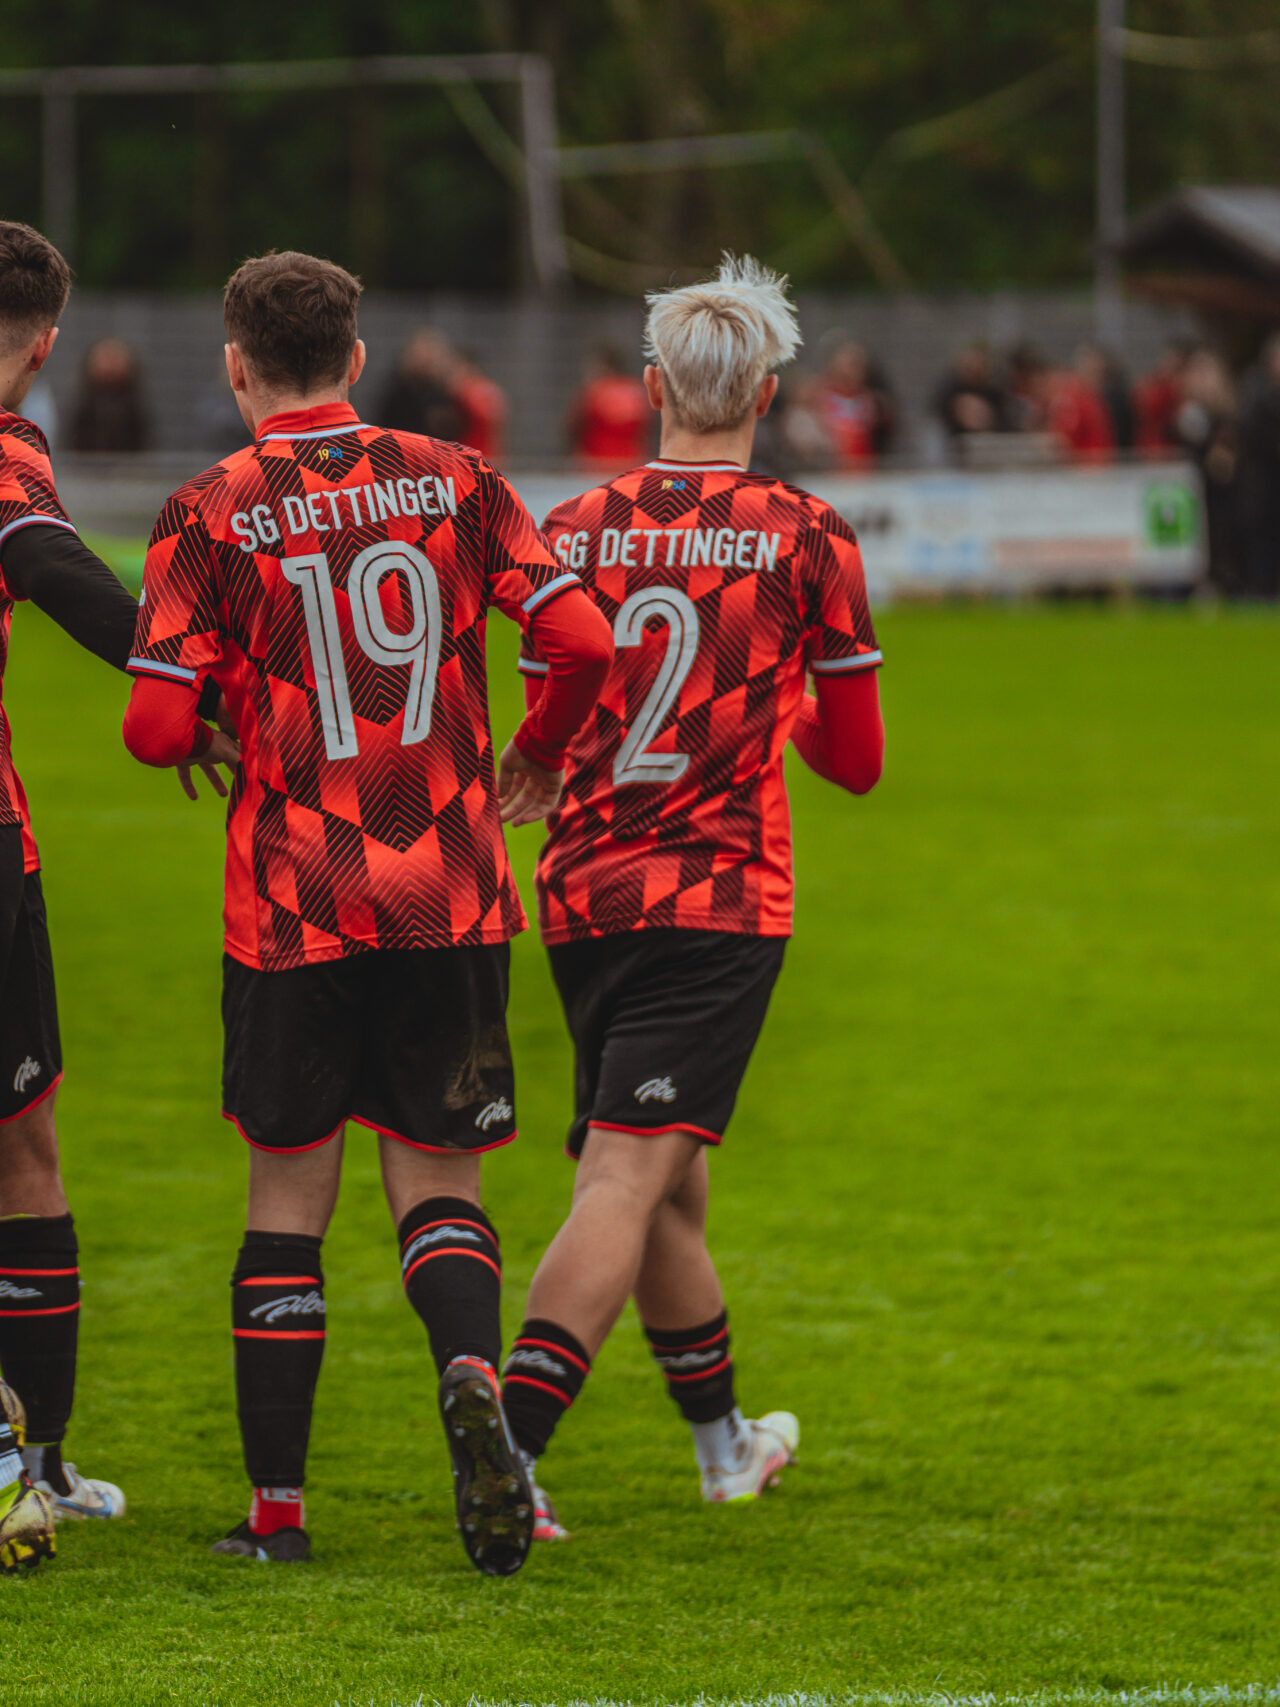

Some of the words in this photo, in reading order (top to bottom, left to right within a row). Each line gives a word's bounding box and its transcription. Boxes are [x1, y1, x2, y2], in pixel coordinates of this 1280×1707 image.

[318, 447, 343, 460] 1958
[231, 504, 281, 552] SG
[282, 476, 457, 535] DETTINGEN
[555, 530, 590, 568] SG
[598, 528, 780, 571] DETTINGEN
[280, 540, 442, 760] 19
[613, 585, 700, 786] 2
